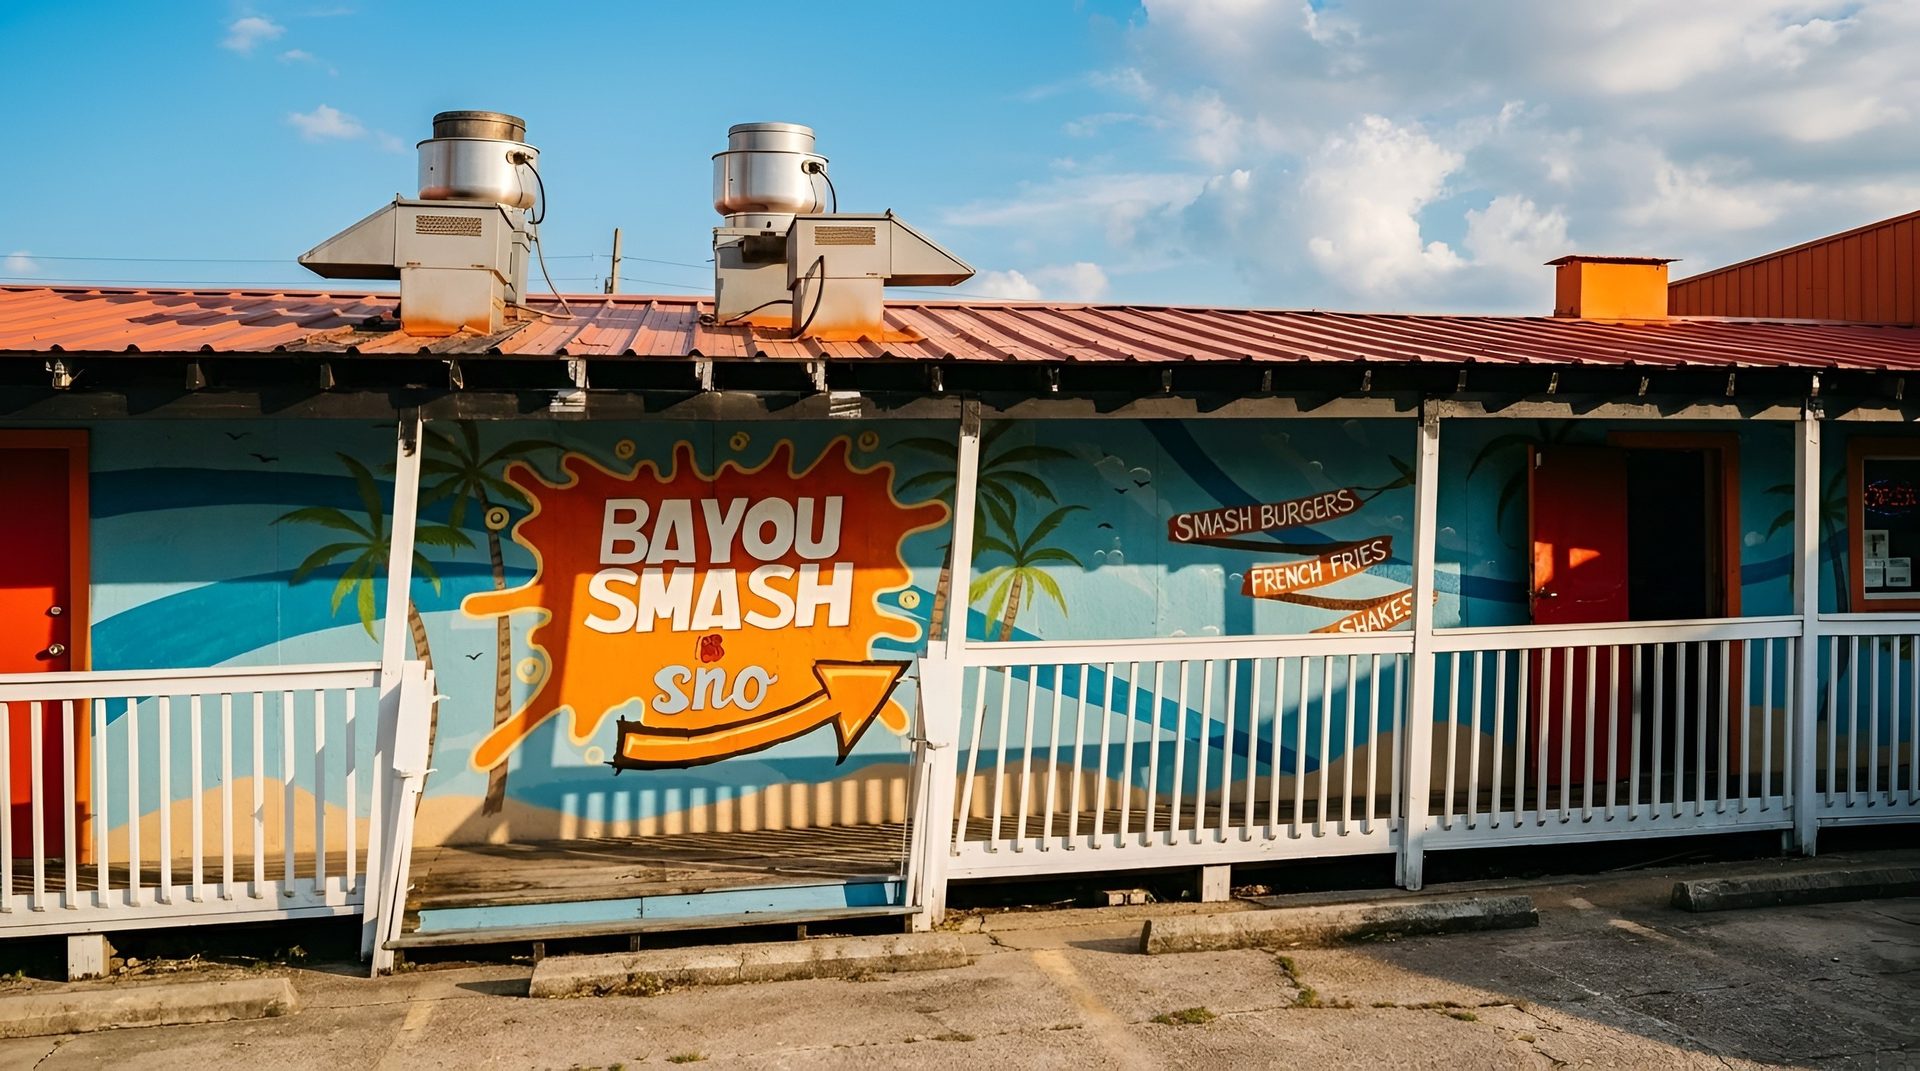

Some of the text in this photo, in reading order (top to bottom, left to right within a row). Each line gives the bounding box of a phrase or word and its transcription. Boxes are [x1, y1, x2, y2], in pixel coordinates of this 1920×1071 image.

[599, 495, 843, 565] BAYOU
[1175, 489, 1354, 542] SMASH BURGERS
[1252, 540, 1387, 595] FRENCH FRIES
[583, 562, 854, 634] SMASH
[651, 664, 778, 715] sno
